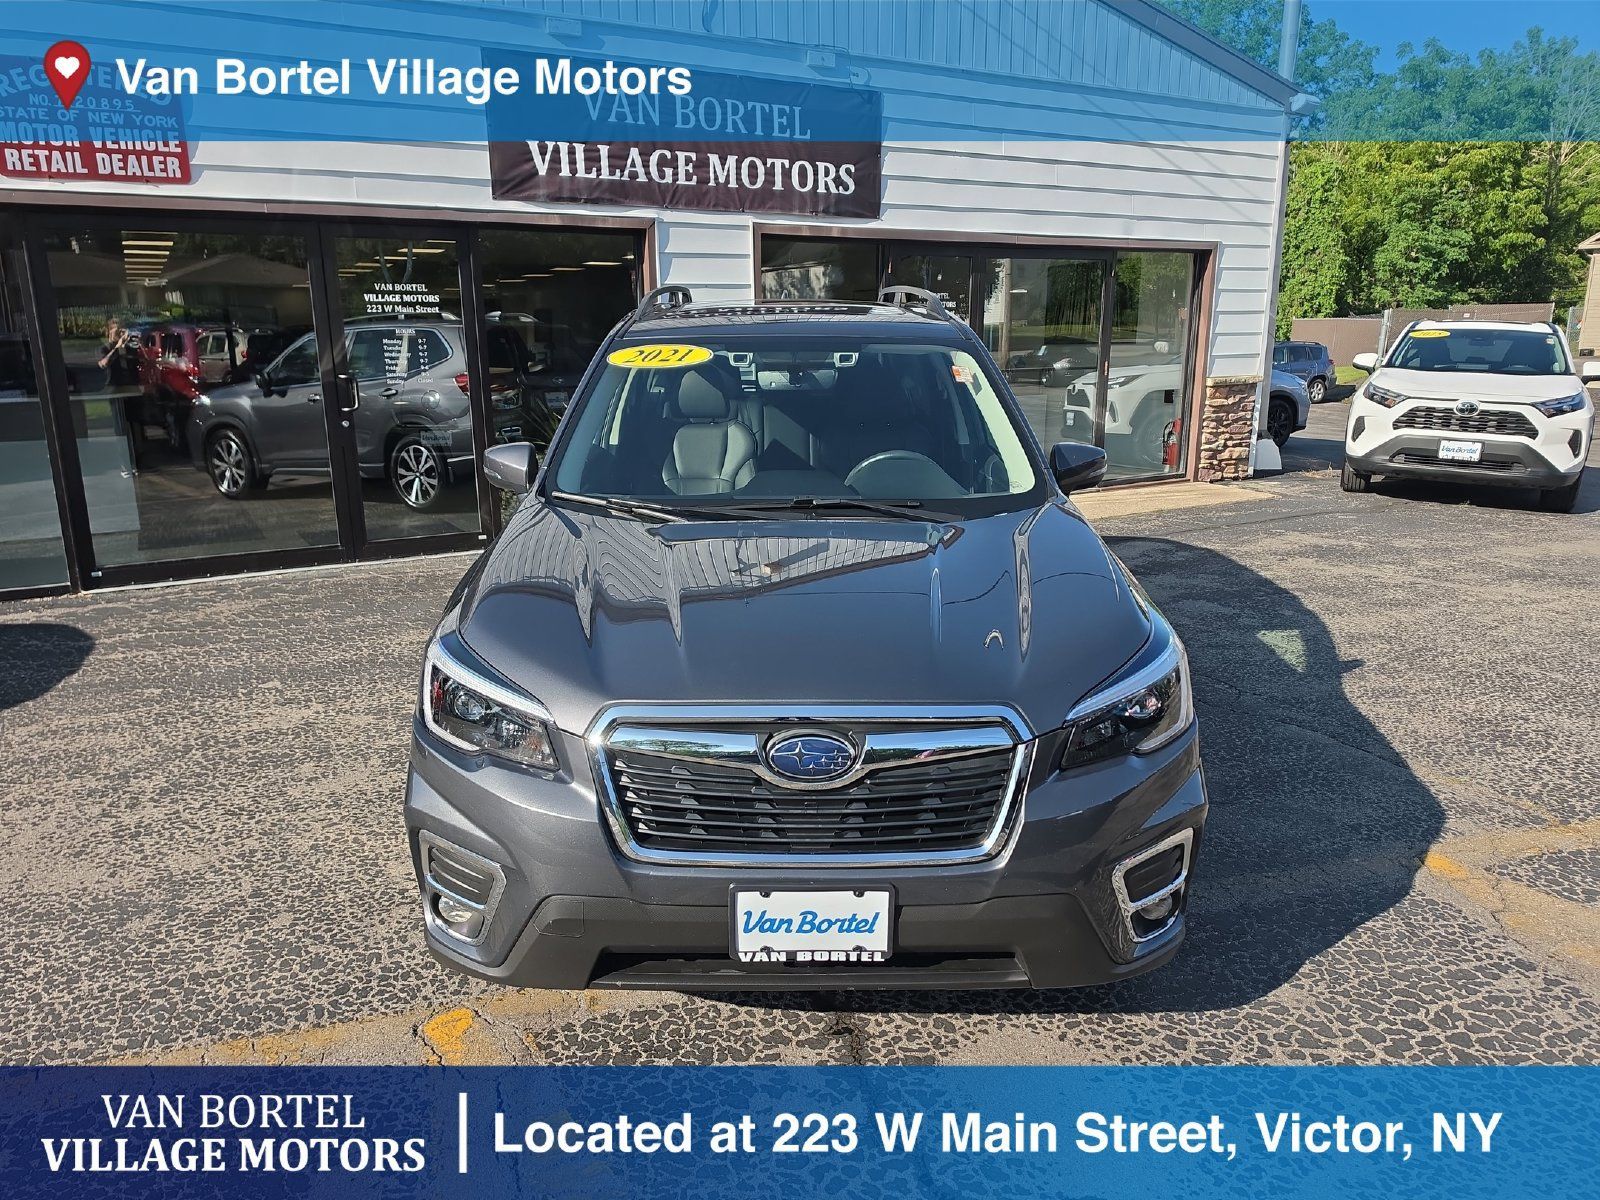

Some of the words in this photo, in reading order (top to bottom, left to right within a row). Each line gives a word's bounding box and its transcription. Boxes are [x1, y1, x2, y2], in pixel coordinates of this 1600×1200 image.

[0, 105, 49, 120] STATE
[56, 109, 79, 121] OF
[87, 111, 125, 125] NEW
[130, 113, 179, 129] YORK
[674, 95, 811, 140] BORTEL
[0, 121, 80, 147] MOTOR
[88, 126, 182, 153] VEHICLE
[4, 148, 89, 175] RETAIL
[95, 152, 182, 178] DEALER
[525, 139, 697, 186] VILLAGE
[706, 152, 855, 195] MOTORS
[363, 293, 402, 302] VILLAGE
[402, 294, 440, 303] MOTORS
[374, 283, 393, 291] VAN
[394, 283, 428, 292] BORTEL
[366, 304, 382, 313] 223
[383, 304, 393, 313] W
[394, 304, 415, 313] Main
[415, 304, 440, 313] Street
[622, 348, 694, 363] 2021
[743, 910, 793, 934] Van
[795, 910, 880, 934] Bortel
[738, 951, 787, 962] VAN
[796, 950, 885, 962] BORTEL
